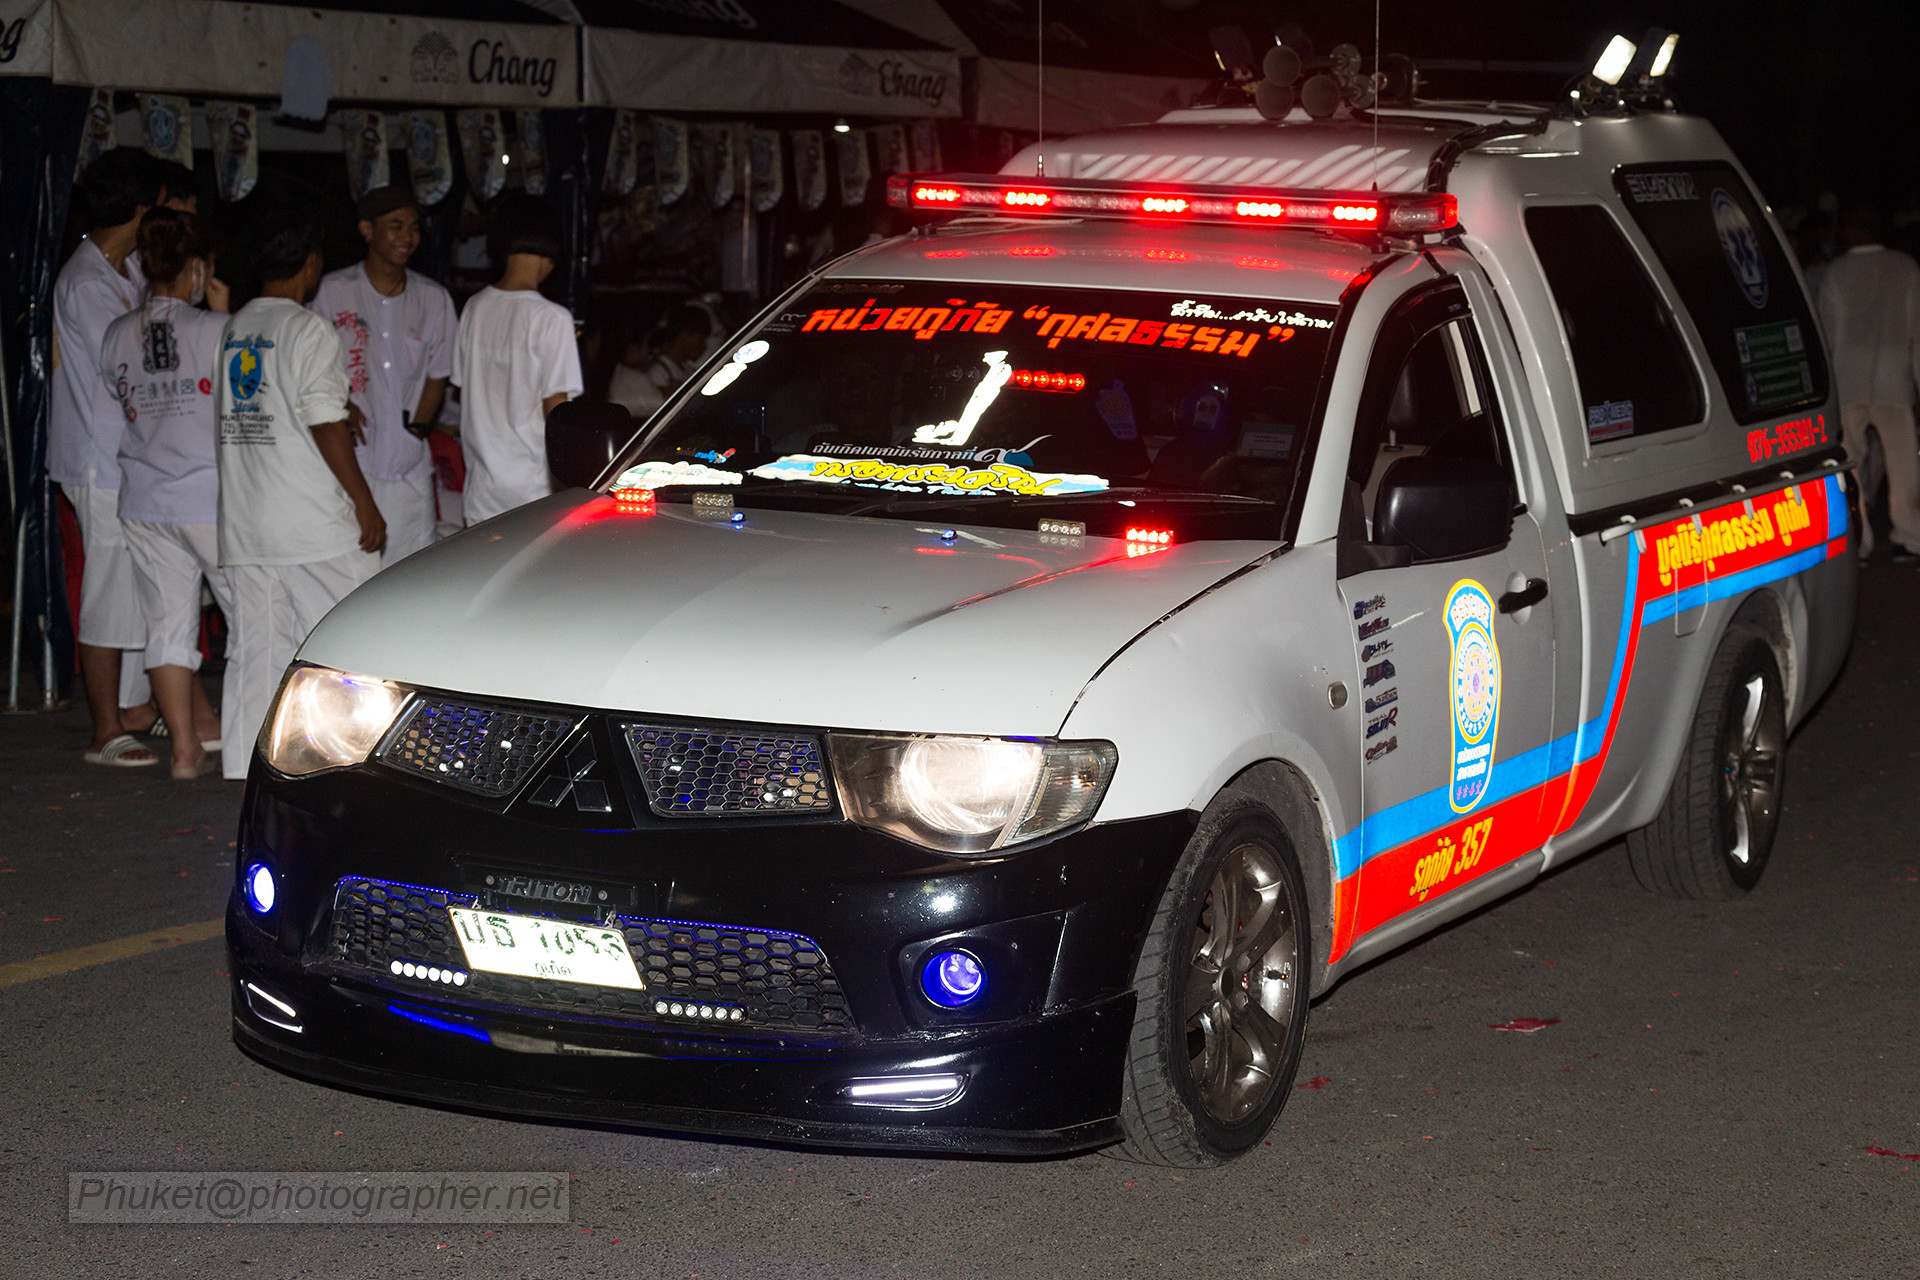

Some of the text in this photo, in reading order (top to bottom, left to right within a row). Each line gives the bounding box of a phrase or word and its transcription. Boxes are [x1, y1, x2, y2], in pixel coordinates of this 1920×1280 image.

[468, 39, 557, 97] Chang
[879, 60, 948, 107] Chang
[802, 298, 1013, 340] หน่วยกู้ภัย
[1450, 592, 1490, 632] RESCUE
[1454, 816, 1494, 876] 357
[498, 876, 593, 904] TRITON
